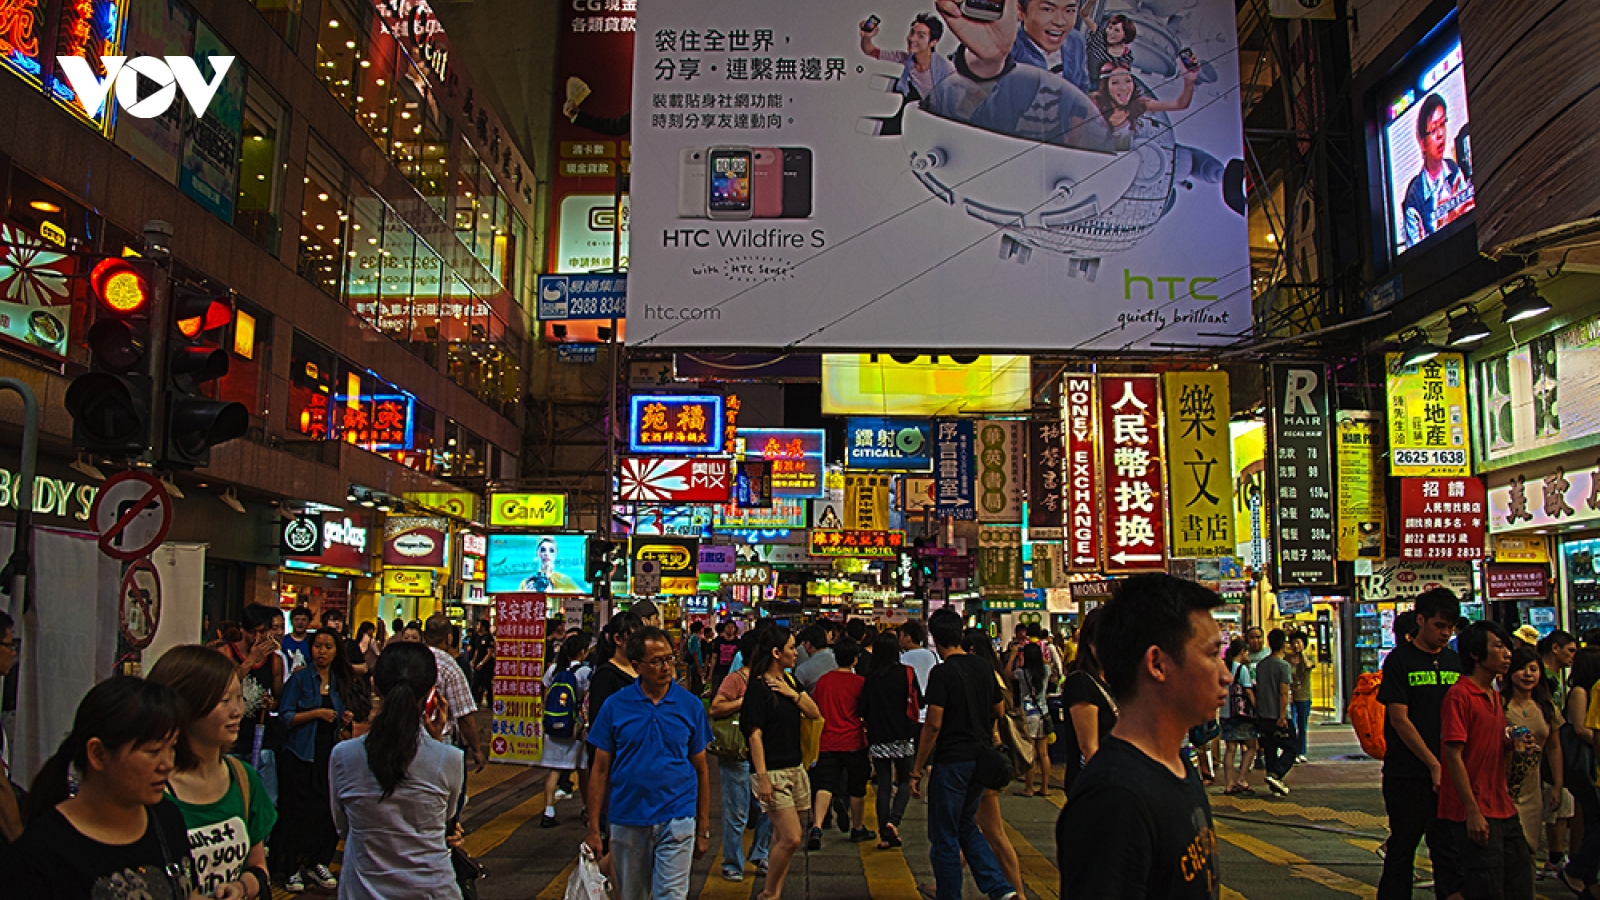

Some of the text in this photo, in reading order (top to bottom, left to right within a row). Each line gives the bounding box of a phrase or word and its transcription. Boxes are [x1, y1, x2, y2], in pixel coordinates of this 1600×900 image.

[663, 228, 825, 248] HTC Wildfire S
[692, 263, 789, 277] with HTC Sense
[644, 304, 721, 321] htc.com
[1118, 308, 1230, 331] quietly brilliant
[1422, 359, 1447, 447] 金源地產
[1284, 416, 1321, 426] HAIR
[1178, 383, 1221, 509] 樂文
[1341, 433, 1362, 445] HAIR
[852, 448, 903, 458] CITICALL
[1396, 451, 1464, 464] 2625 1638
[1069, 379, 1092, 555] MONEY EXCHANGE
[1111, 381, 1155, 547] 人民幣找換
[690, 475, 725, 489] MX
[1180, 514, 1228, 543] 書店
[863, 545, 893, 555] HOTEL
[1073, 582, 1109, 597] MONEY
[1407, 671, 1438, 687] CEDAR
